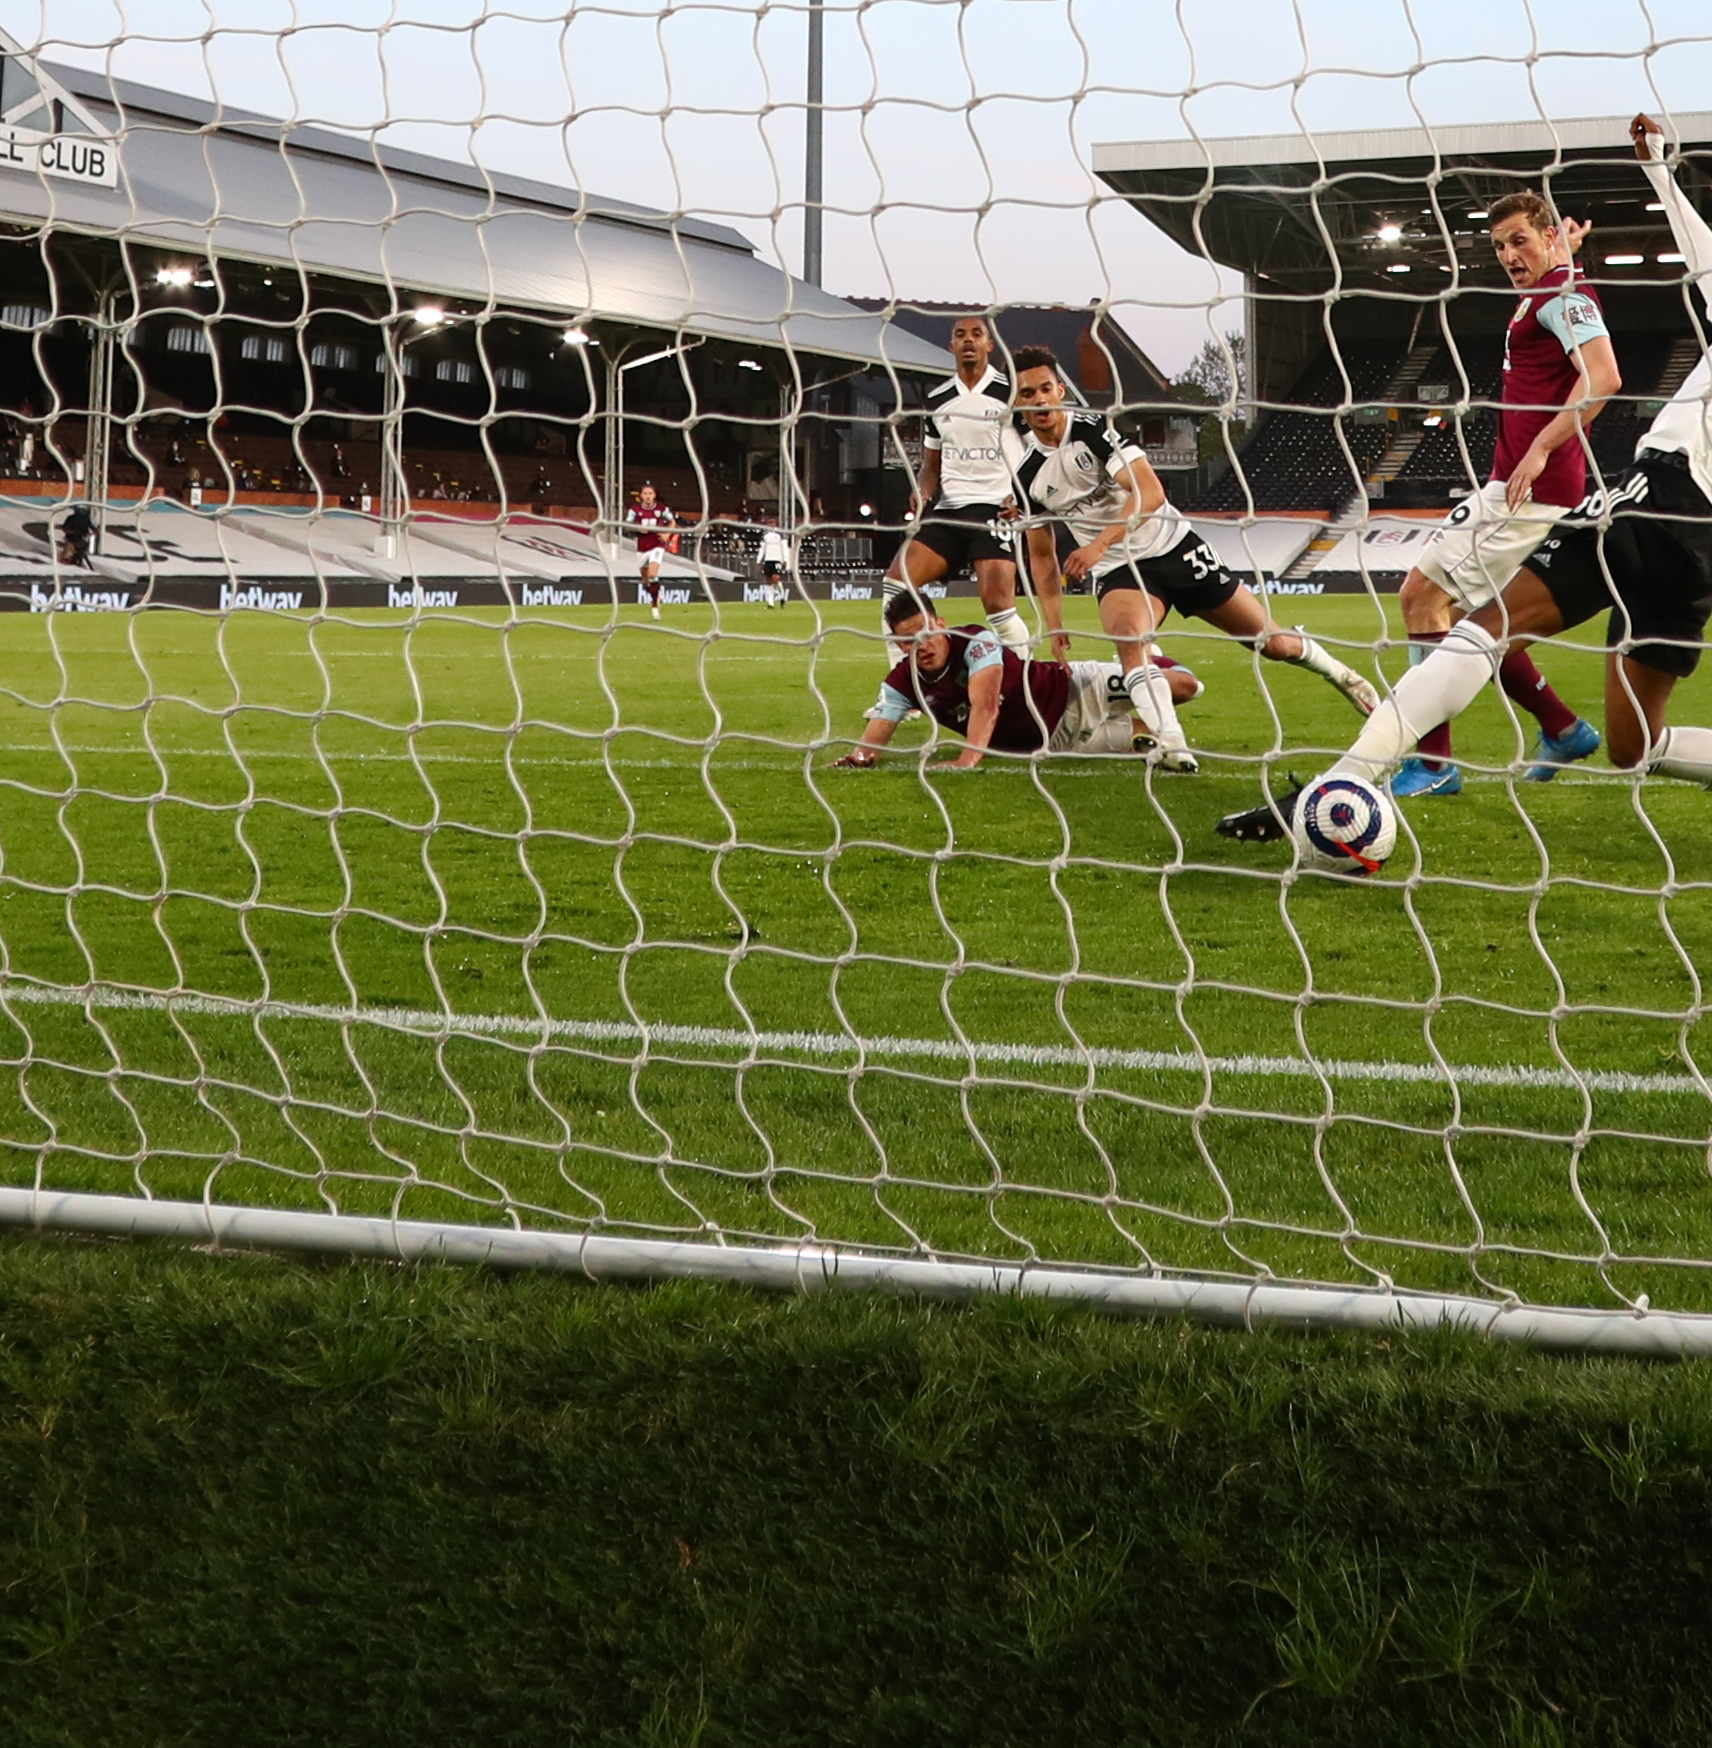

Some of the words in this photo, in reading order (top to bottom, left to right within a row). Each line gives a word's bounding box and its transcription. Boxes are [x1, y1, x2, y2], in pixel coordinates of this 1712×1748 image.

[39, 141, 106, 178] CLUB
[1450, 504, 1471, 526] 9
[1182, 544, 1219, 580] 33
[30, 584, 129, 613] betway
[219, 584, 302, 611] betway
[388, 583, 458, 608] betway
[522, 583, 582, 606] betway
[831, 582, 872, 600] betway
